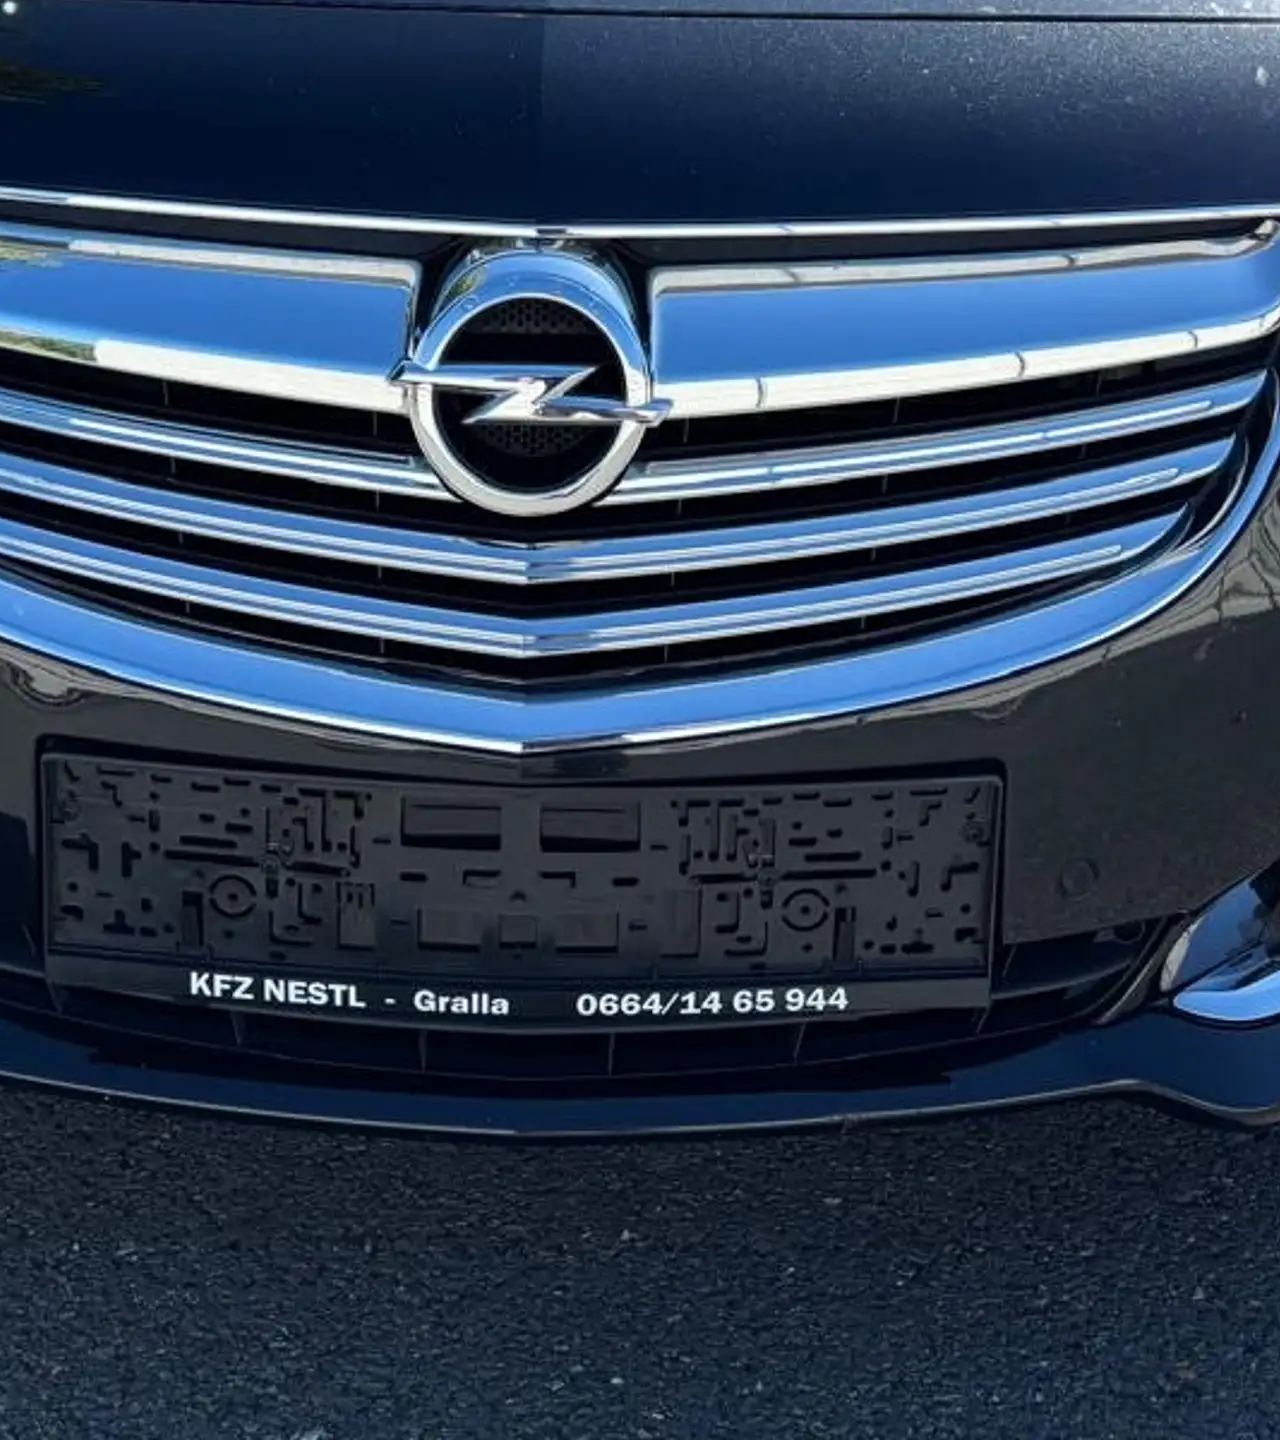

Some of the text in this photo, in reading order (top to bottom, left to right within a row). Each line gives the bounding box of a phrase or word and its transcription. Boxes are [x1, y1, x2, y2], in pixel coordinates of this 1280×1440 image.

[190, 971, 255, 1000] KFZ
[263, 978, 367, 1008] NESTL
[413, 989, 510, 1015] Gralla
[576, 990, 723, 1016] 0664/14
[732, 988, 776, 1013] 65
[784, 986, 849, 1012] 944
